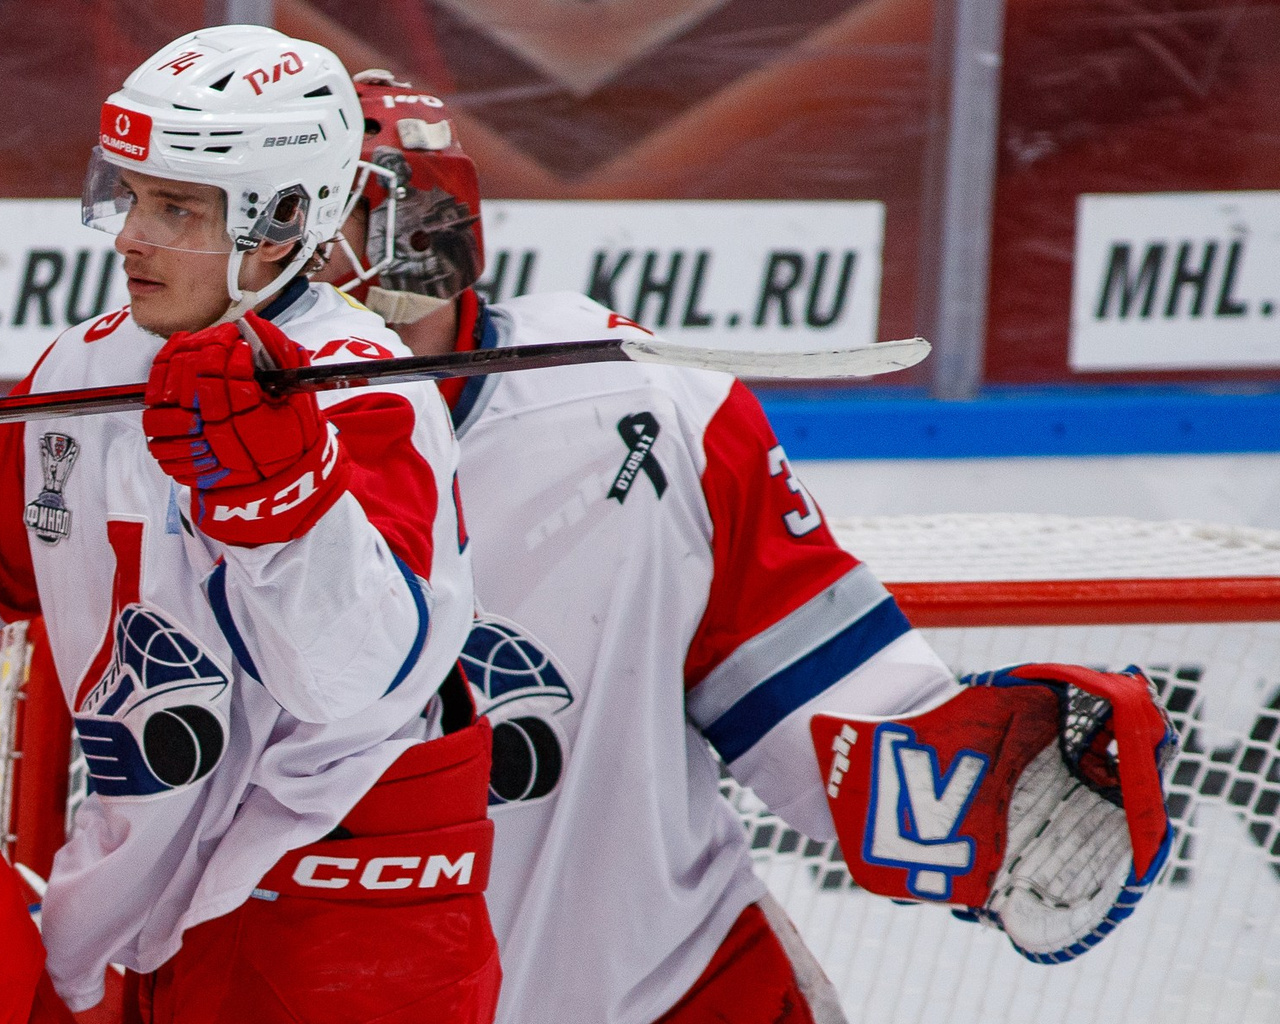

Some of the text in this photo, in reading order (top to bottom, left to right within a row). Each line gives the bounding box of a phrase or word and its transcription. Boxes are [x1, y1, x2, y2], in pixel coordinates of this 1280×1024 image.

[102, 133, 147, 157] OLIMPBET
[235, 236, 261, 250] CCM
[1093, 239, 1274, 320] MHL.
[615, 433, 656, 491] 07.09.11
[24, 503, 71, 536] ФИНАЛ
[291, 851, 476, 891] CCM
